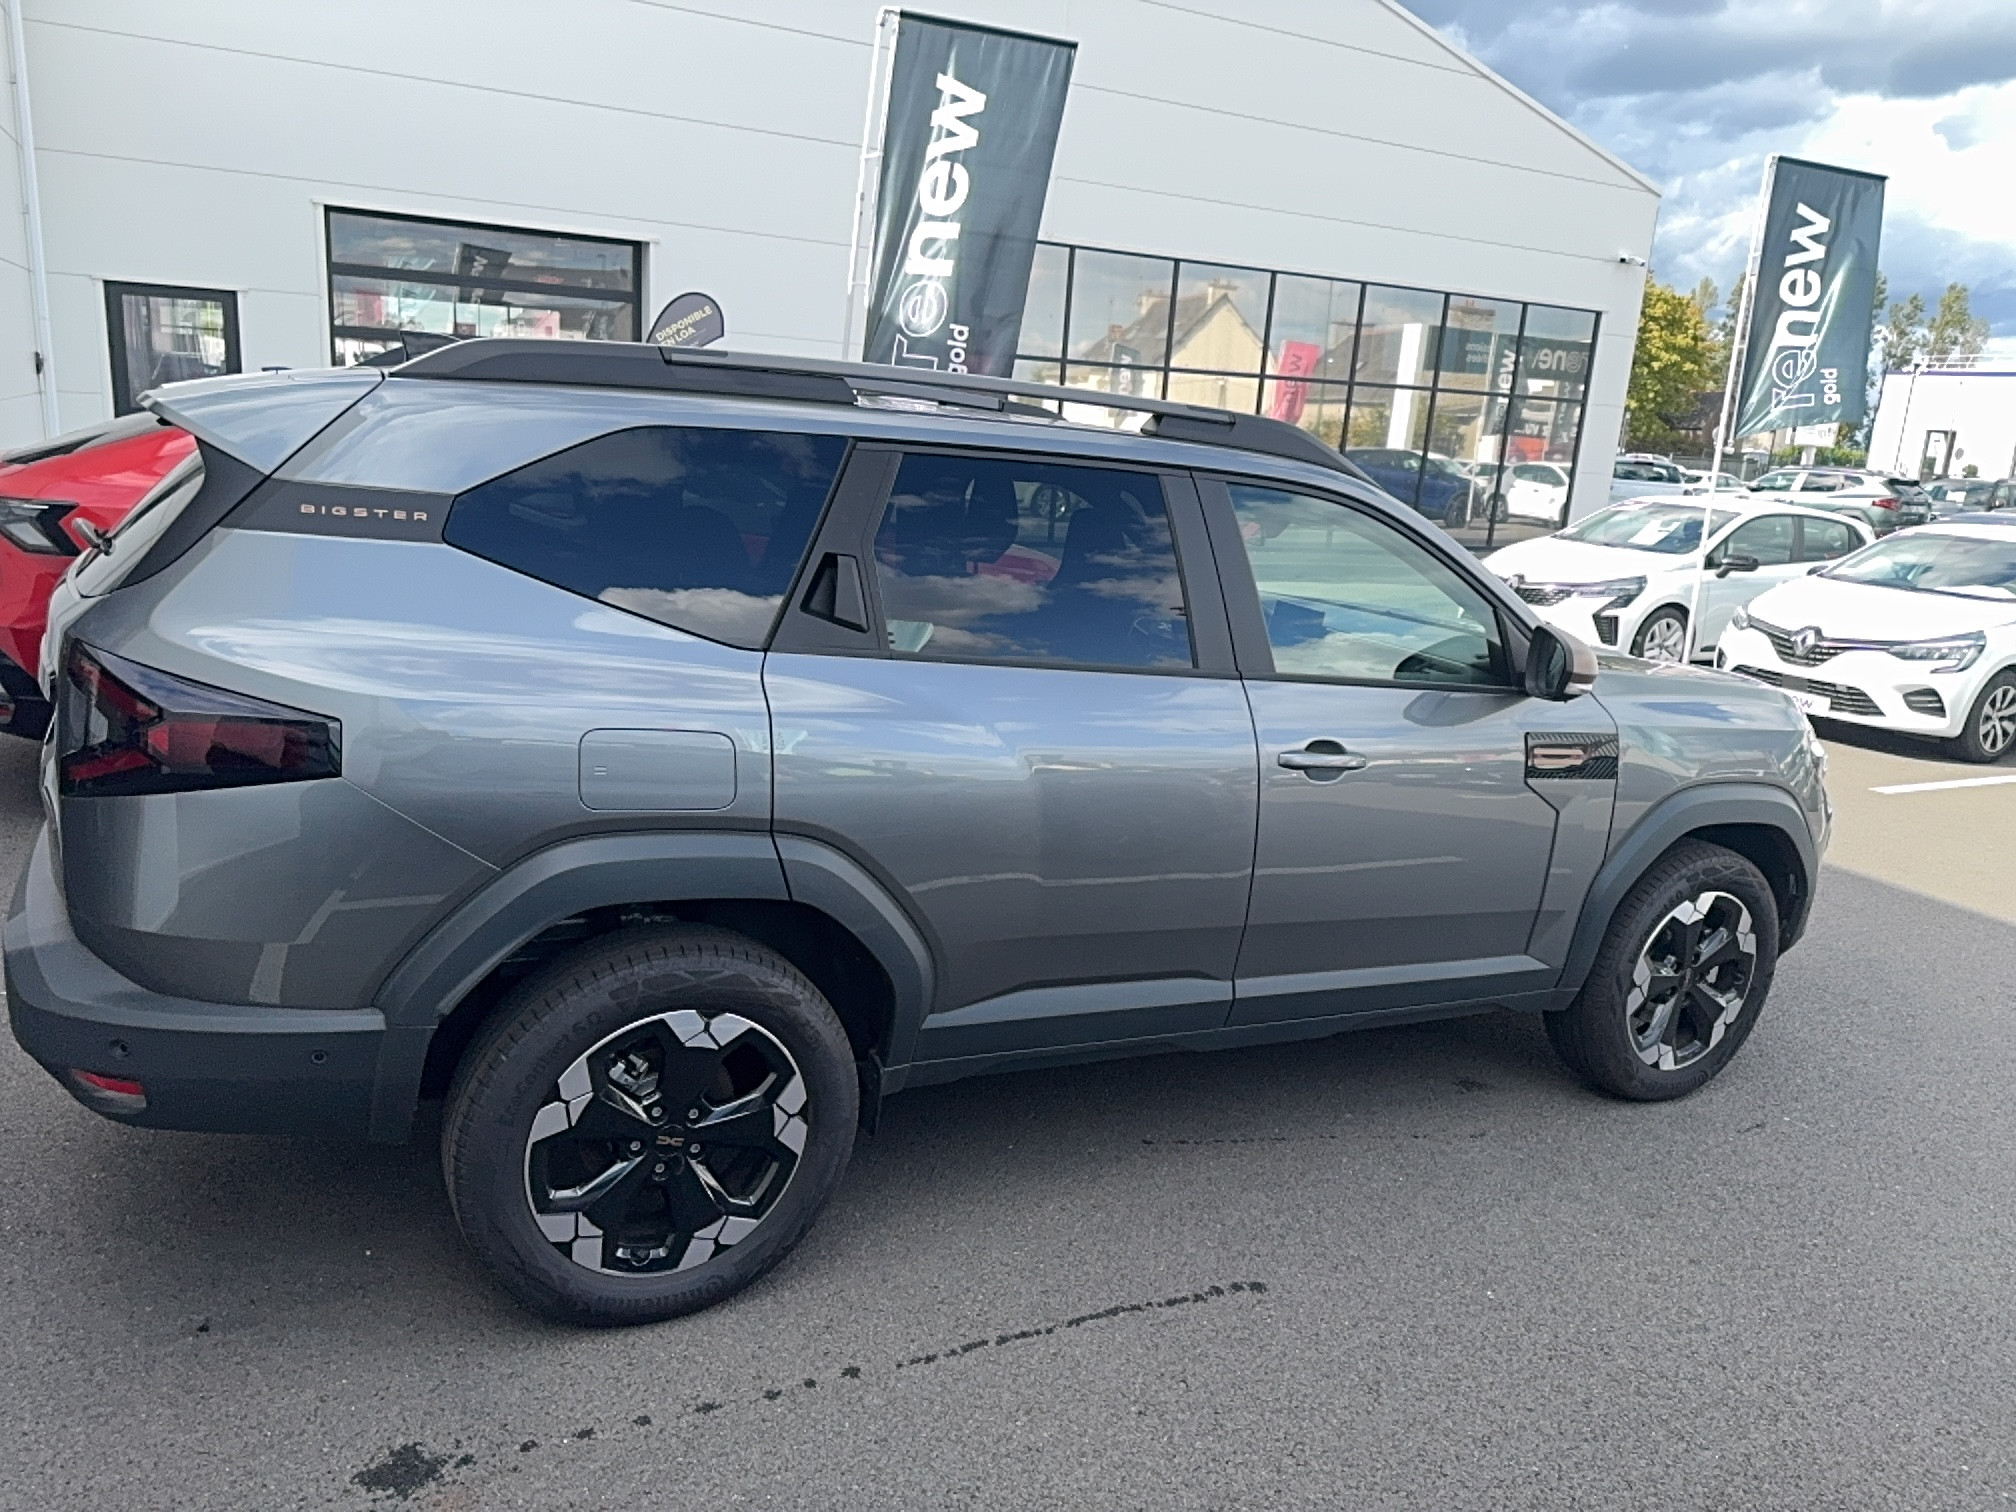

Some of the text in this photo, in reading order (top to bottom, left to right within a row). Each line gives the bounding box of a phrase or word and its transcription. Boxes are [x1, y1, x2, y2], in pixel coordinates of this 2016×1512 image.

[892, 72, 987, 370] renew
[655, 305, 713, 341] DISPONIBLE
[1770, 202, 1831, 413] renew
[674, 326, 697, 342] LOA
[947, 323, 970, 374] gold
[1820, 367, 1841, 405] gold
[301, 504, 427, 521] BIGSTER
